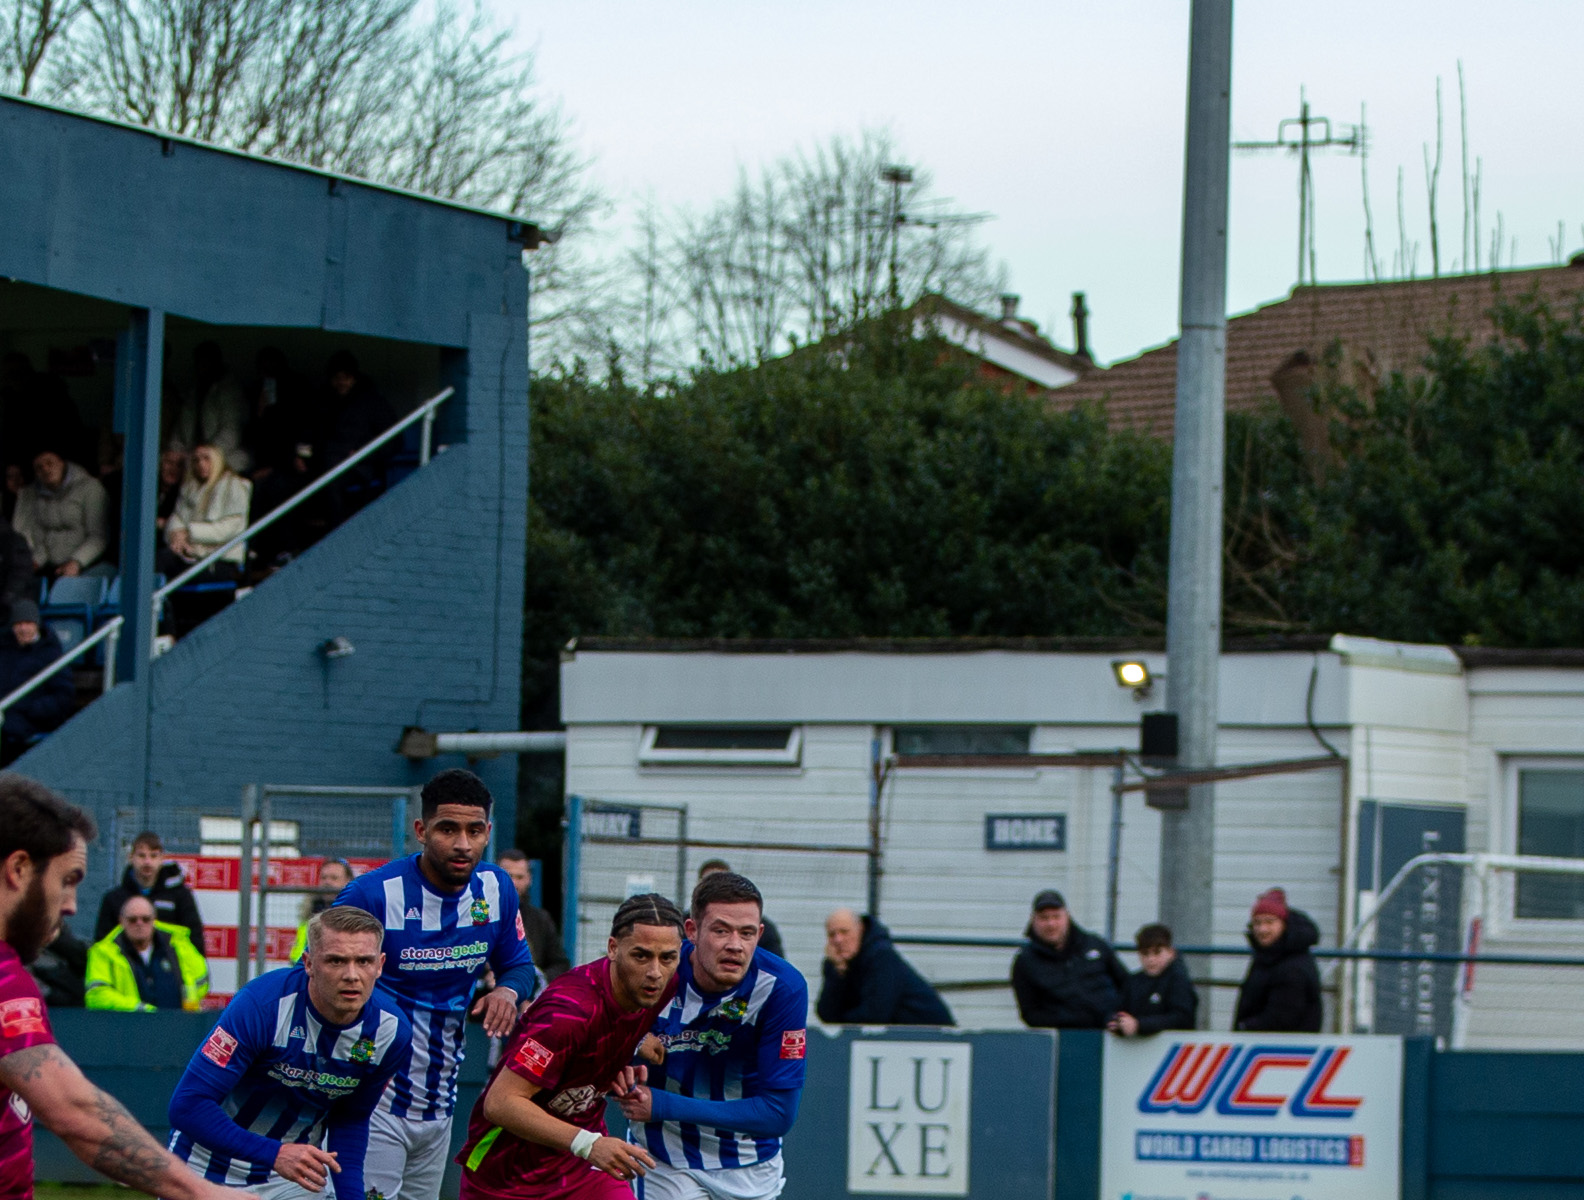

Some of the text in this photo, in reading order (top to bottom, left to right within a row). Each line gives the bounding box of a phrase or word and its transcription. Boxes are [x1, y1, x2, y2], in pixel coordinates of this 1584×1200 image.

[993, 818, 1058, 844] HOME
[400, 940, 488, 961] storagegeeks
[1137, 1042, 1365, 1119] WCL
[1138, 1133, 1195, 1158] WORLD
[1199, 1135, 1255, 1160] CARGO
[1258, 1136, 1349, 1164] LOGISTICS
